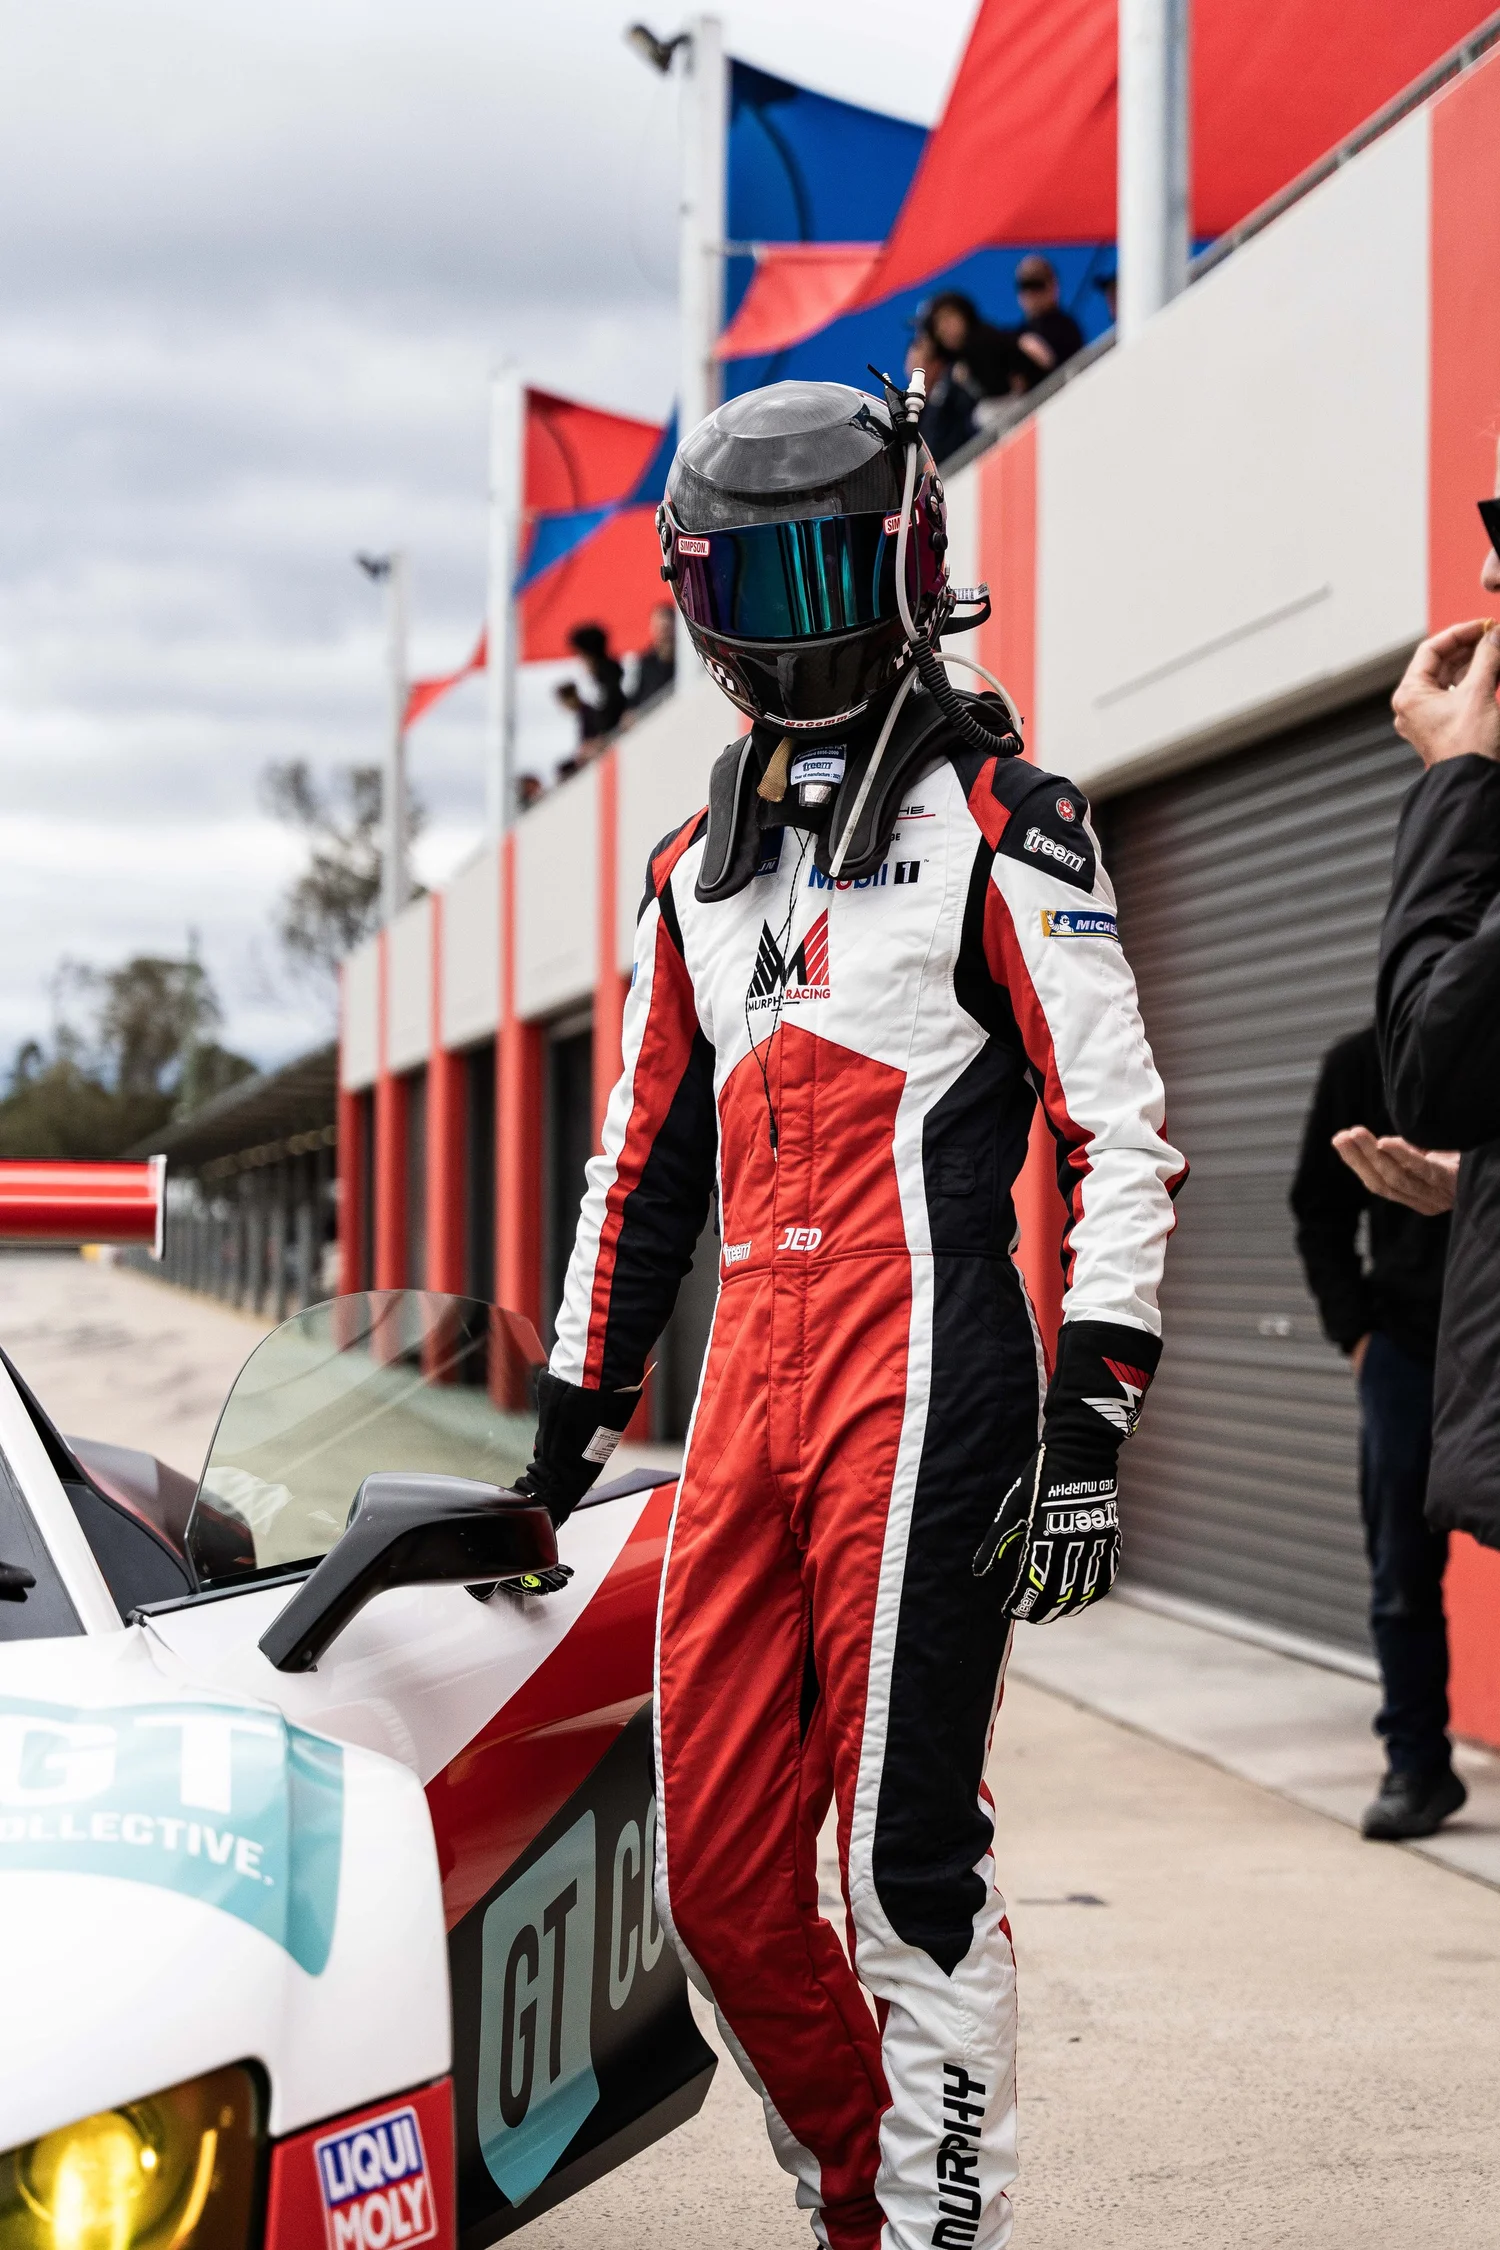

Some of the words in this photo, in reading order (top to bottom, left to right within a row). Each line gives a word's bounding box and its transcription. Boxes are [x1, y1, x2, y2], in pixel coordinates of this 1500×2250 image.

[679, 540, 707, 553] SIMPSON
[802, 762, 832, 772] freem
[1024, 827, 1086, 872] freem
[785, 988, 831, 1000] RACING
[777, 1227, 822, 1251] JED
[723, 1241, 752, 1267] freem
[1048, 1481, 1098, 1497] MURPHY
[1099, 1479, 1114, 1491] JED
[0, 1714, 280, 1815] GT
[500, 1877, 577, 2128] GT
[322, 2118, 419, 2203] LIQUI
[931, 2063, 986, 2250] MURPHY
[332, 2175, 425, 2250] MOLY
